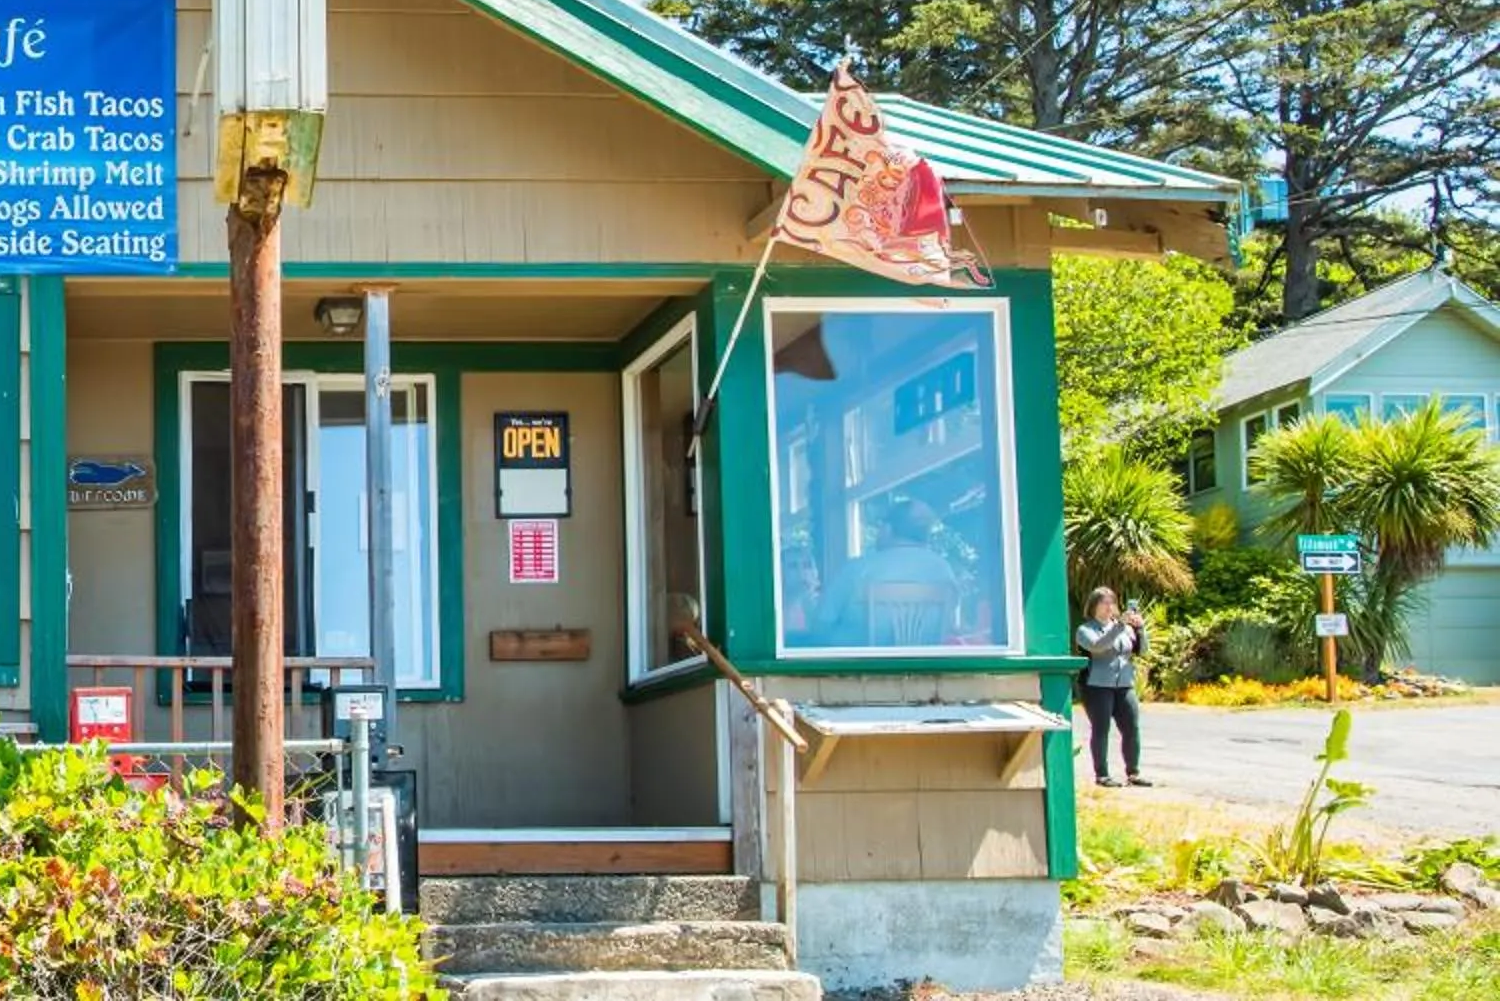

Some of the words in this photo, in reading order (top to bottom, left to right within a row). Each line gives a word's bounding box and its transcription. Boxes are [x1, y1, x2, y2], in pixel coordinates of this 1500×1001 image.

[15, 90, 75, 116] Fish
[84, 92, 164, 118] Tacos
[7, 126, 75, 151] Crab
[84, 127, 164, 152] Tacos
[105, 161, 164, 186] Melt
[49, 195, 164, 220] Allowed
[62, 230, 165, 262] Seating
[503, 427, 561, 458] OPEN
[68, 489, 147, 503] WELCOME
